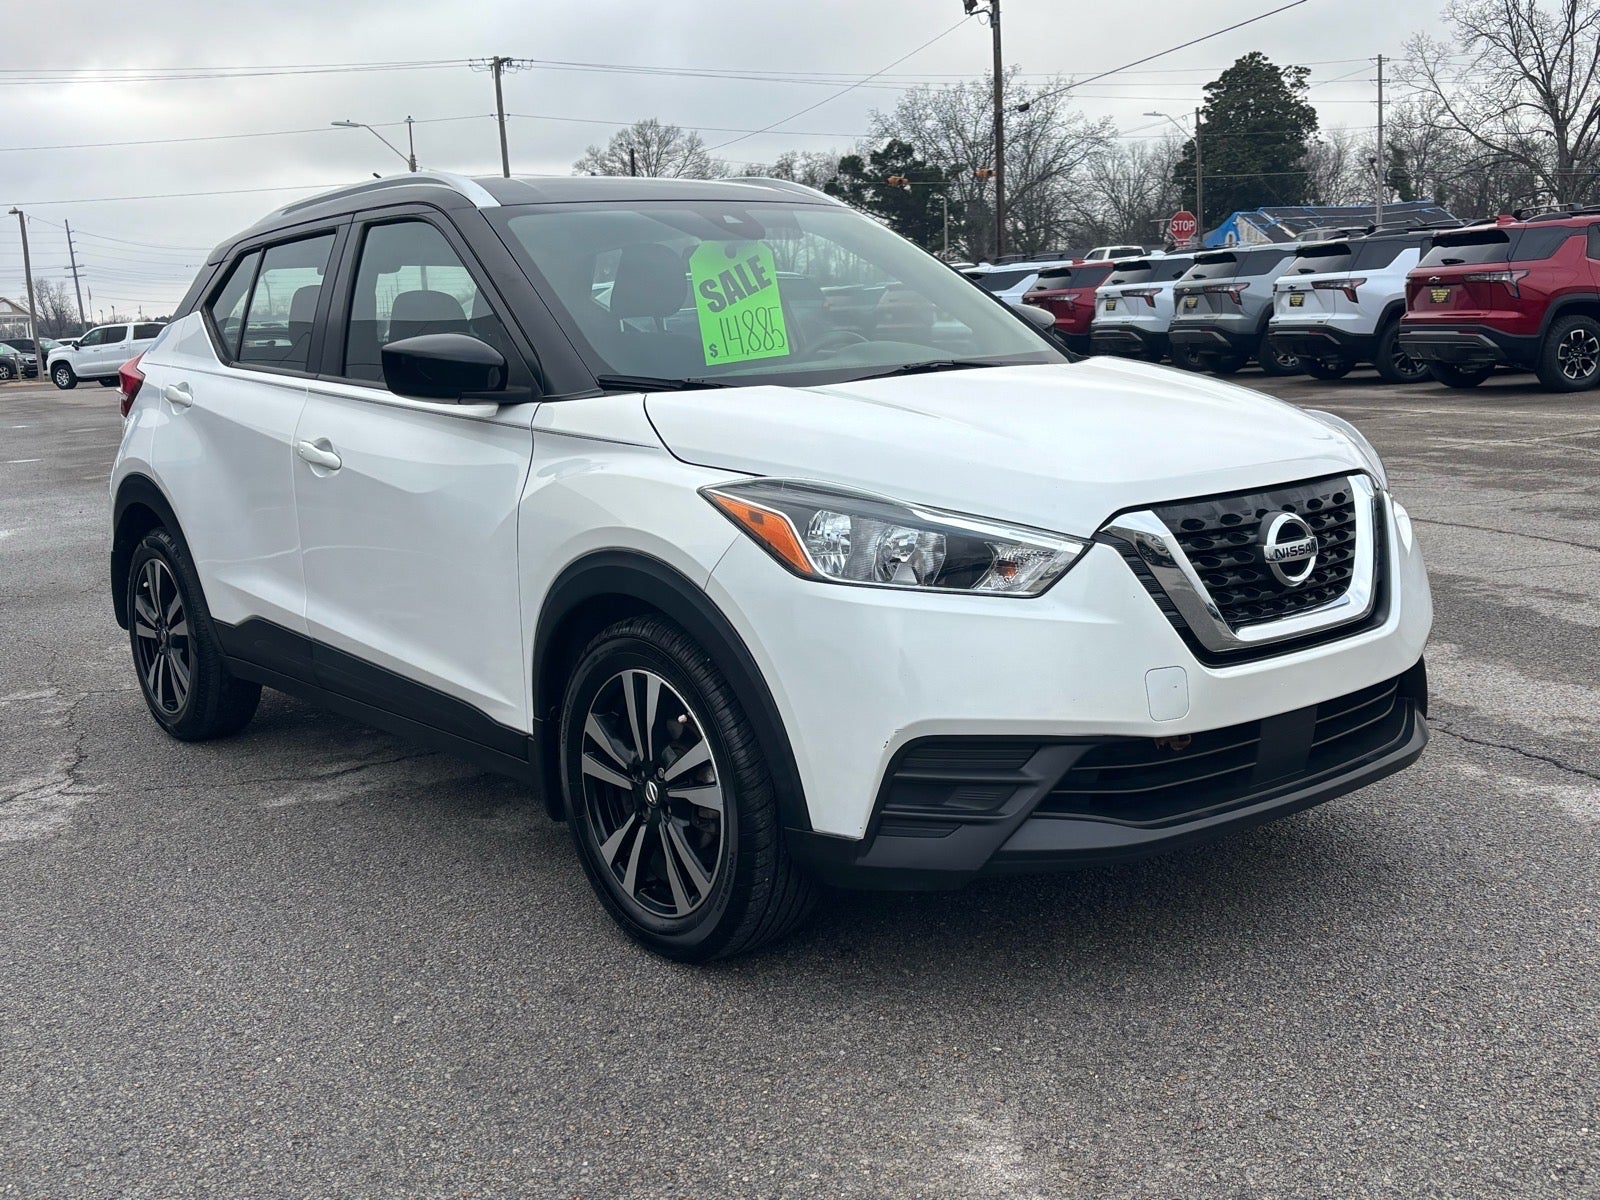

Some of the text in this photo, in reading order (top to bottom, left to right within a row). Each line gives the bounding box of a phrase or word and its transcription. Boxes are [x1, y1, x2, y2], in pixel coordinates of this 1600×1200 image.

[1172, 220, 1195, 231] STOP
[698, 254, 772, 313] SALE
[1274, 541, 1317, 559] NISSAN
